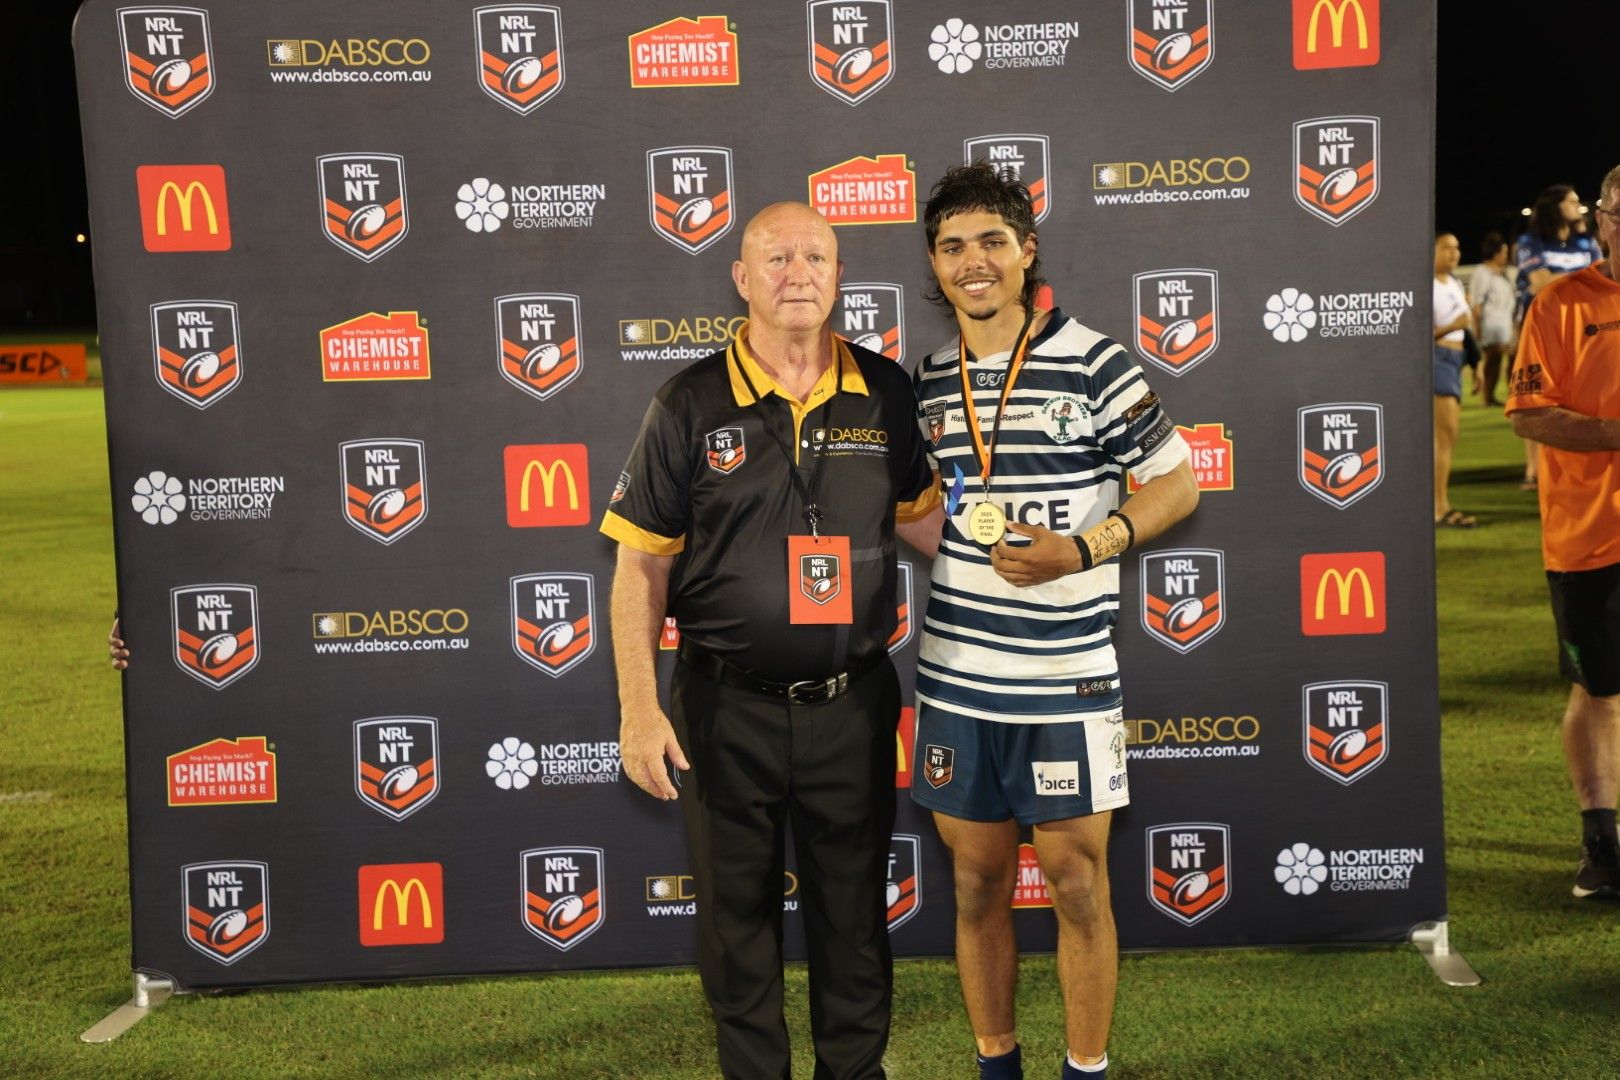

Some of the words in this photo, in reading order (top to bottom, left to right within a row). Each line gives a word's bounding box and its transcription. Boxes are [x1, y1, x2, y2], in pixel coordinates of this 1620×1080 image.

[833, 6, 867, 21] NRL
[1152, 8, 1188, 30] NT
[145, 17, 182, 32] NRL
[500, 15, 535, 30] NRL
[833, 23, 868, 44] NT
[985, 22, 1079, 41] NORTHERN
[147, 34, 184, 55] NT
[501, 32, 536, 53] NT
[985, 40, 1069, 57] TERRITORY
[301, 38, 430, 66] DABSCO
[637, 42, 730, 64] CHEMIST
[985, 56, 1065, 69] GOVERNMENT
[271, 69, 431, 83] www.dabsco.com.au
[638, 66, 728, 78] WAREHOUSE
[1319, 127, 1354, 142] NRL
[990, 145, 1024, 159] NRL
[1319, 143, 1354, 165] NT
[343, 164, 379, 178] NRL
[672, 157, 707, 171] NRL
[1125, 157, 1250, 188] DABSCO
[344, 180, 380, 201] NT
[673, 173, 708, 194] NT
[816, 180, 908, 203] CHEMIST
[512, 184, 606, 201] NORTHERN
[1094, 187, 1250, 205] www.dabsco.com.au
[512, 201, 596, 218] TERRITORY
[817, 203, 906, 216] WAREHOUSE
[513, 217, 592, 229] GOVERNMENT
[1158, 280, 1193, 294] NRL
[844, 294, 878, 308] NRL
[1159, 296, 1193, 317] NT
[1320, 292, 1413, 310] NORTHERN
[177, 311, 213, 326] NRL
[520, 304, 555, 318] NRL
[1320, 309, 1403, 326] TERRITORY
[845, 310, 879, 331] NT
[178, 328, 213, 349] NT
[521, 320, 555, 341] NT
[651, 317, 749, 344] DABSC
[1320, 324, 1400, 337] GOVERNMENT
[328, 337, 421, 359] CHEMIST
[330, 360, 420, 372] WAREHOUSE
[1323, 414, 1357, 428] NRL
[716, 439, 733, 450] NT
[830, 428, 888, 444] DABSCO
[1323, 429, 1358, 450] NT
[365, 449, 399, 463] NRL
[366, 465, 400, 486] NT
[189, 477, 284, 495] NORTHERN
[189, 493, 275, 510] TERRITORY
[190, 508, 271, 520] GOVERNMENT
[976, 499, 1071, 534] ICE
[1089, 523, 1124, 550] LOVE
[811, 558, 828, 566] NRL
[1165, 559, 1199, 573] NRL
[811, 566, 829, 577] NT
[535, 583, 569, 597] NRL
[1165, 575, 1199, 595] NT
[197, 594, 232, 609] NRL
[536, 599, 570, 619] NT
[198, 610, 232, 631] NT
[345, 608, 468, 637] DABSCO
[314, 637, 469, 653] www.dabsco.com.au
[1328, 691, 1362, 705] NRL
[1328, 706, 1363, 727] NT
[379, 727, 413, 741] NRL
[1137, 716, 1260, 743] DABSCO
[379, 742, 414, 763] NT
[541, 742, 620, 759] NORTHER
[932, 748, 945, 757] NRL
[541, 758, 622, 774] TERRITORY
[932, 756, 945, 766] NT
[174, 761, 269, 784] CHEMIST
[541, 773, 619, 785] GOVERNMENT
[175, 784, 266, 797] WAREHOUSE
[1045, 779, 1075, 790] DICE
[1171, 833, 1205, 847] NRL
[545, 857, 579, 871] NRL
[1171, 848, 1205, 869] NT
[1330, 848, 1423, 866] NORTHERN
[207, 871, 242, 885] NRL
[1330, 865, 1414, 881] TERRITORY
[545, 872, 579, 893] NT
[1330, 879, 1410, 892] GOVERNMENT
[208, 887, 243, 907] NT
